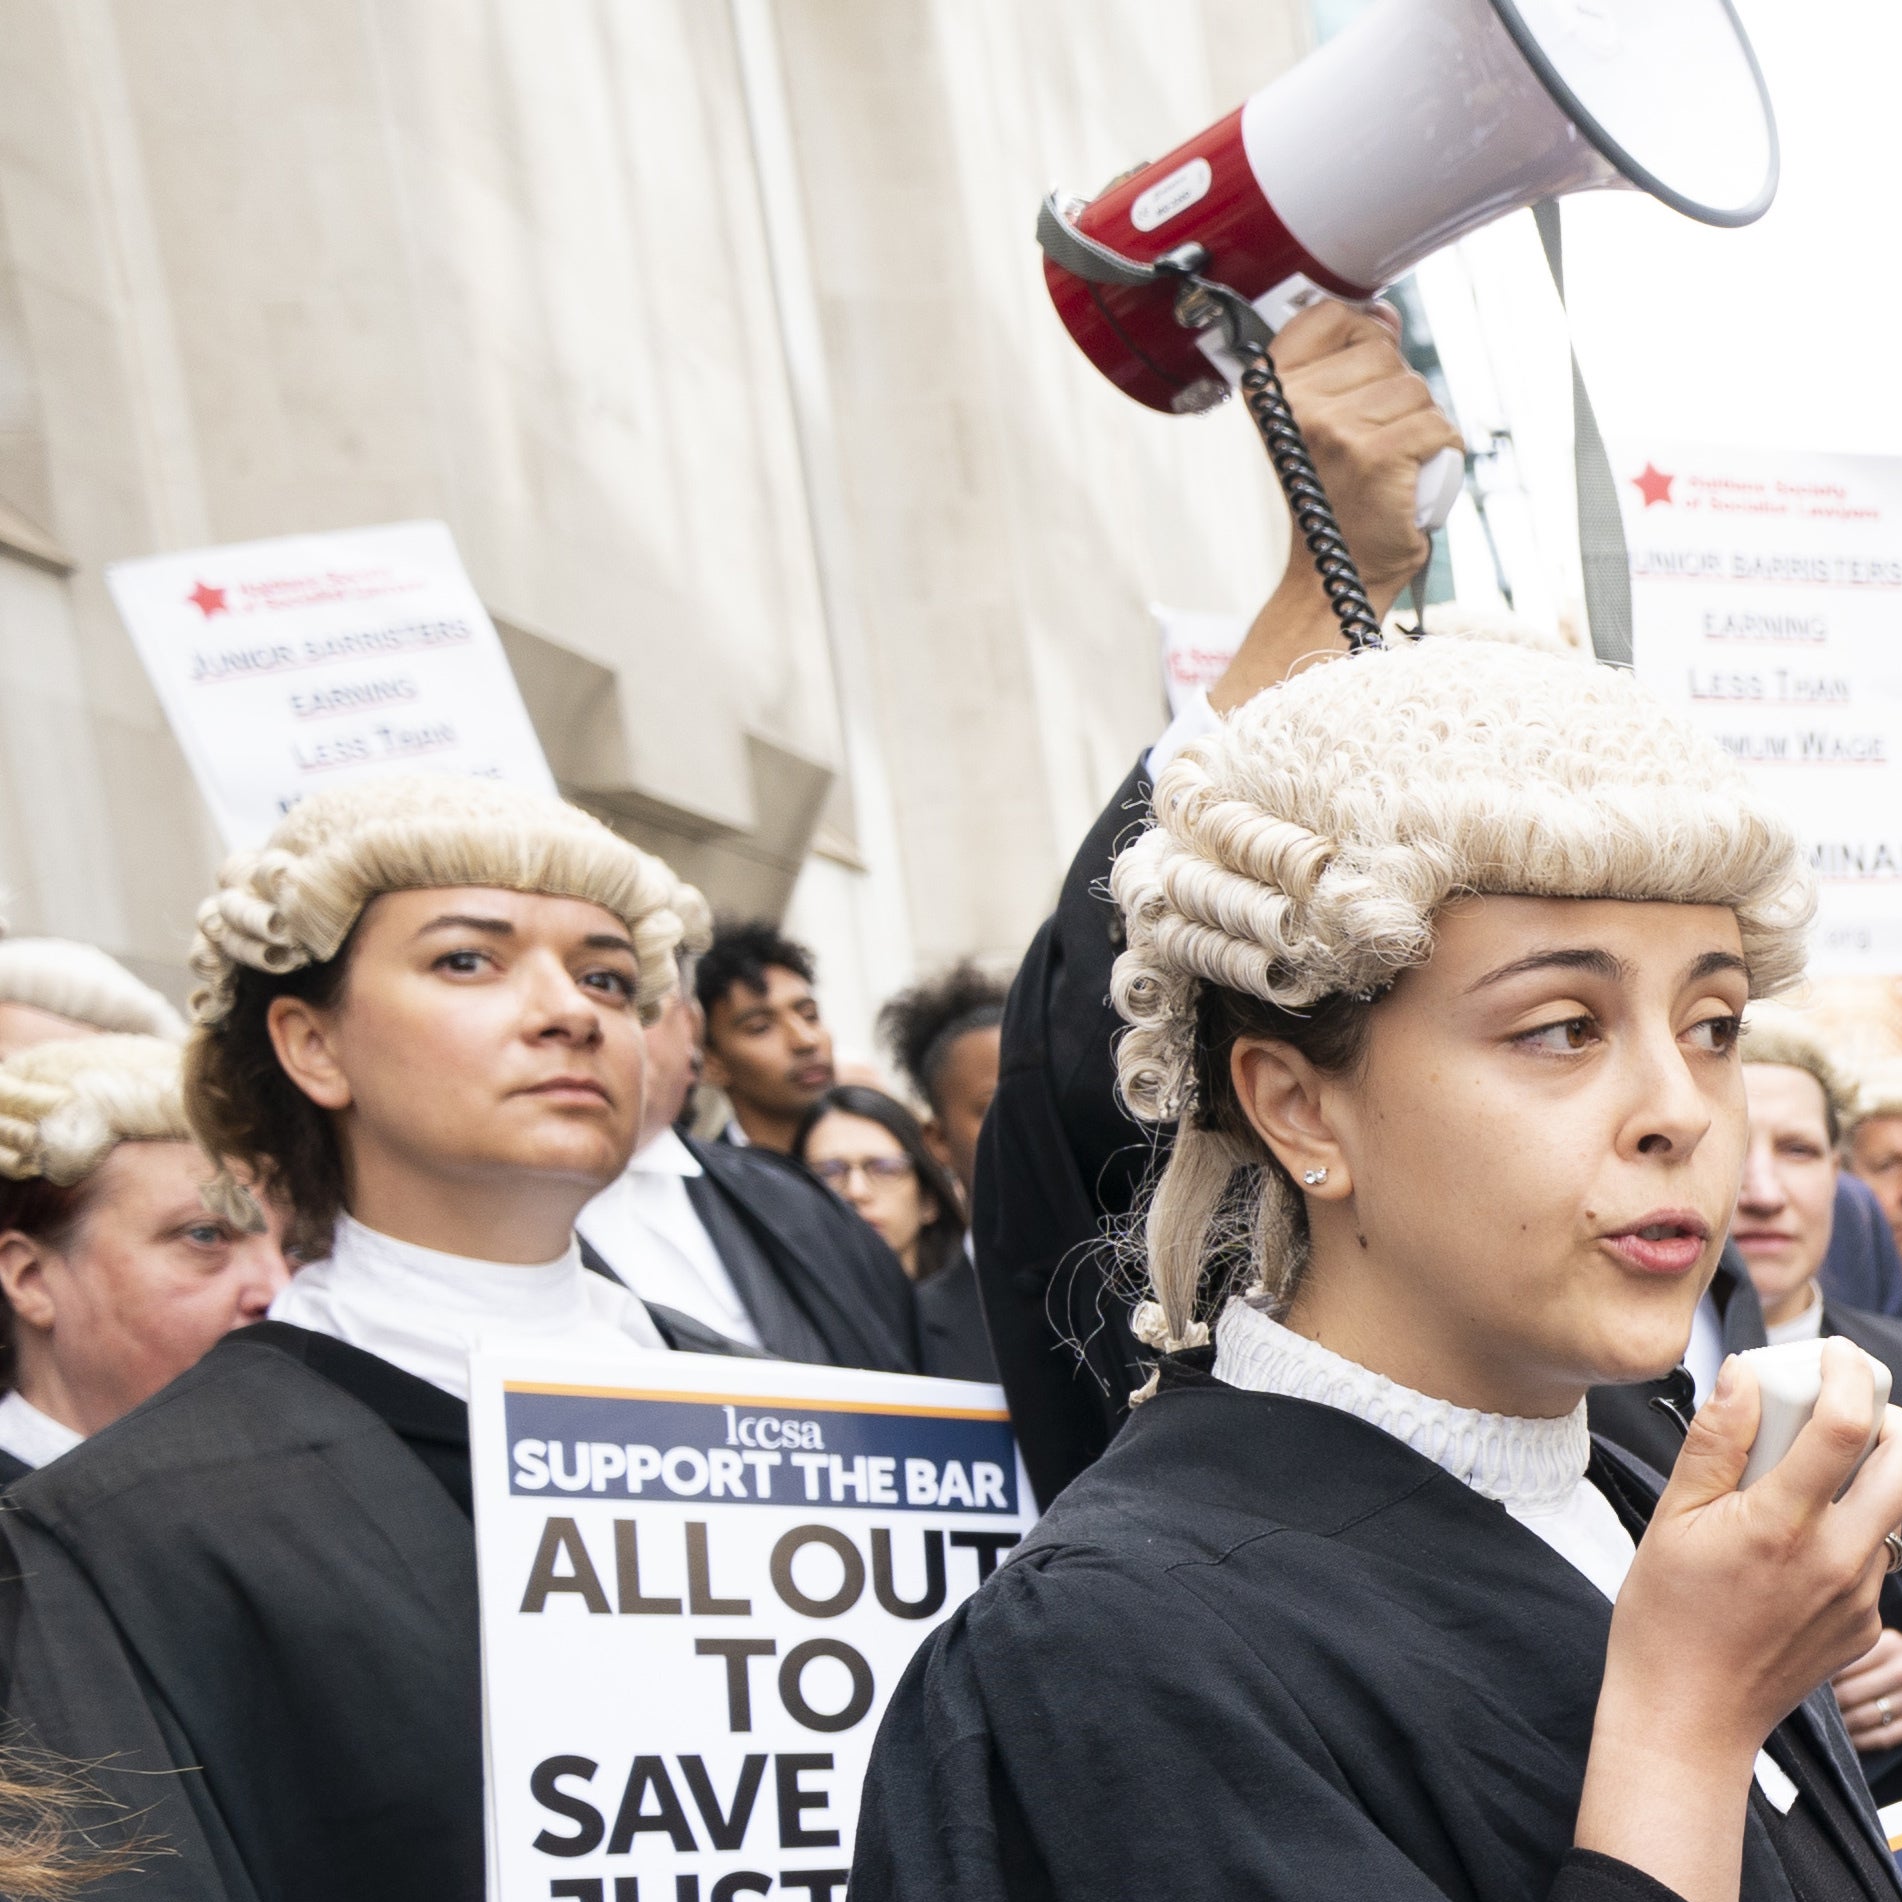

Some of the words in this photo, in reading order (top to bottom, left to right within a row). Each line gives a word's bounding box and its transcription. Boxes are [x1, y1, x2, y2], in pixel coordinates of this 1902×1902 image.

[1630, 551, 1721, 576] UNIOR
[1704, 611, 1827, 643] EARNING
[722, 1405, 826, 1451] lccsa
[512, 1438, 782, 1499] SUPPORT
[790, 1452, 899, 1504] THE
[905, 1458, 1009, 1509] BAR
[518, 1516, 753, 1616] ALL
[769, 1523, 1022, 1621] OUT
[694, 1637, 876, 1733] TO
[530, 1753, 841, 1858] SAVE
